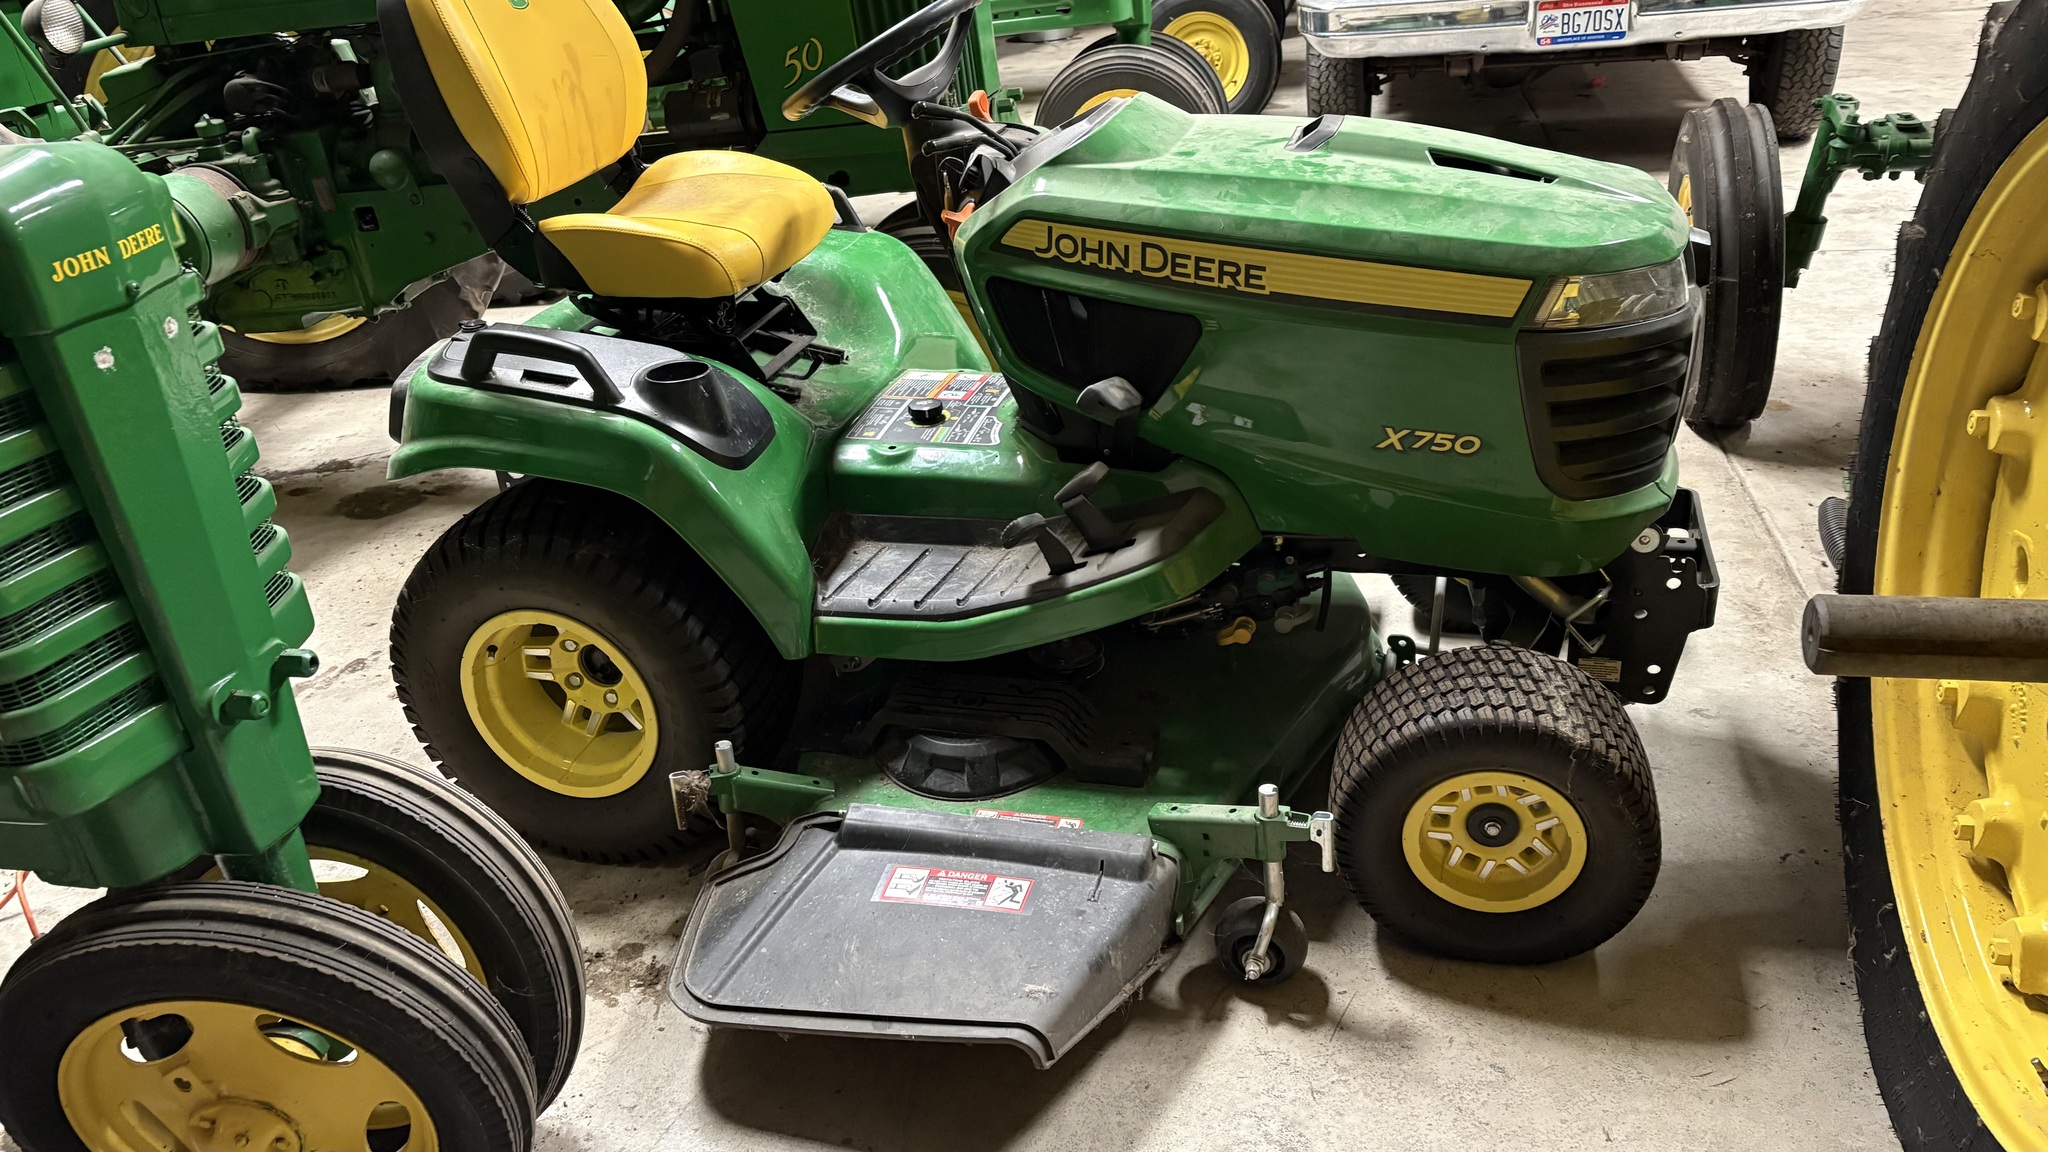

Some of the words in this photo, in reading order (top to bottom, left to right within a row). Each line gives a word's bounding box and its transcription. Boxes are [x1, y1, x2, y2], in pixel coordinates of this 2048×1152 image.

[783, 37, 823, 89] 50
[51, 246, 111, 283] JOHN
[117, 223, 165, 260] DEERE
[1034, 225, 1130, 270] JOHN
[1140, 241, 1267, 292] DEERE
[1375, 426, 1482, 455] X750
[947, 870, 989, 881] DANGER
